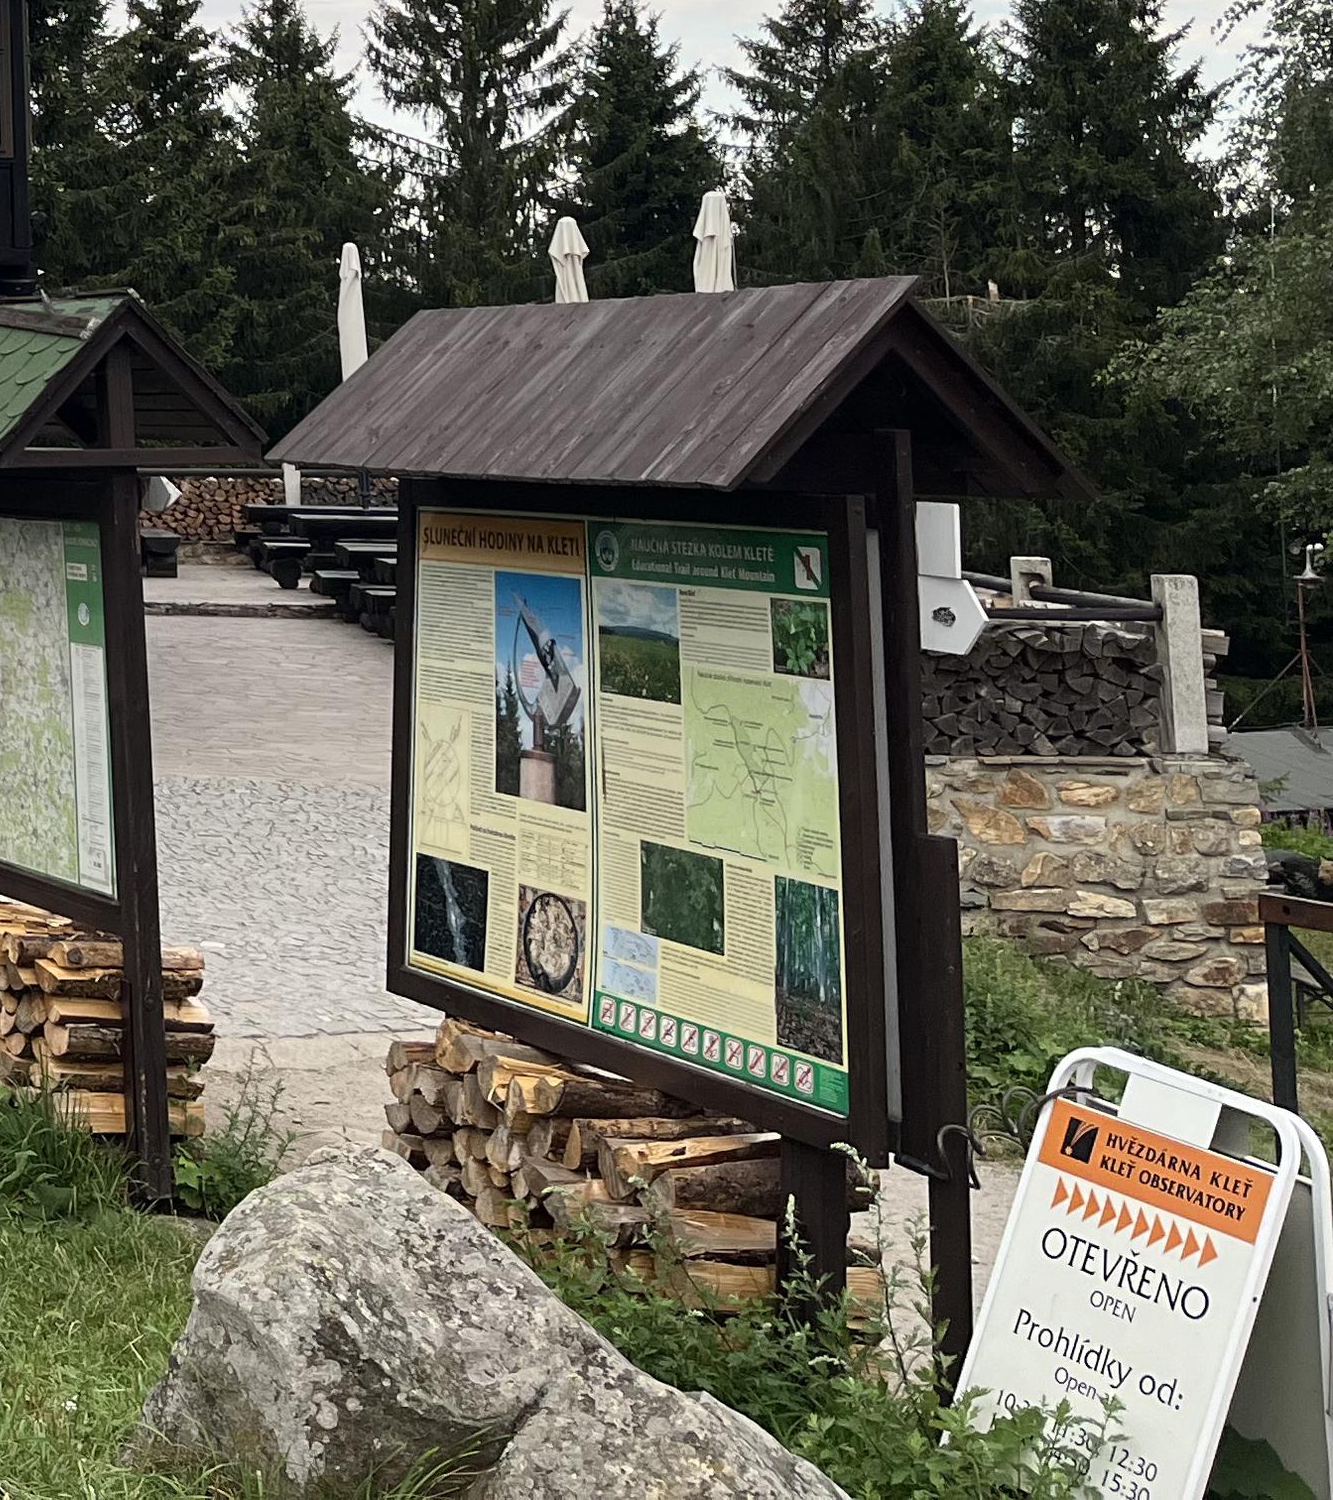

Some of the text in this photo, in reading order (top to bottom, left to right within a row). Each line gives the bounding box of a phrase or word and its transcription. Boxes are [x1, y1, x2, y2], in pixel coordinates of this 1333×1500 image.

[423, 525, 581, 557] SLUNEČNÍ HODINY NA KLETI
[708, 543, 743, 560] KOLEM
[631, 558, 673, 574] Educational
[674, 562, 690, 575] Trail
[692, 565, 719, 578] around
[738, 567, 775, 583] Mountain
[1106, 1132, 1253, 1198] HVĚZDÁRNA KLEŤ
[1100, 1155, 1247, 1221] KLEŤ OBSERVATORY
[1041, 1227, 1209, 1320] OTEVŘENO
[1090, 1290, 1136, 1323] OPEN
[1013, 1308, 1183, 1410] Prohlídky od:
[1054, 1366, 1097, 1400] Open
[1109, 1446, 1158, 1482] 12:30
[1102, 1469, 1150, 1500] 15:30
